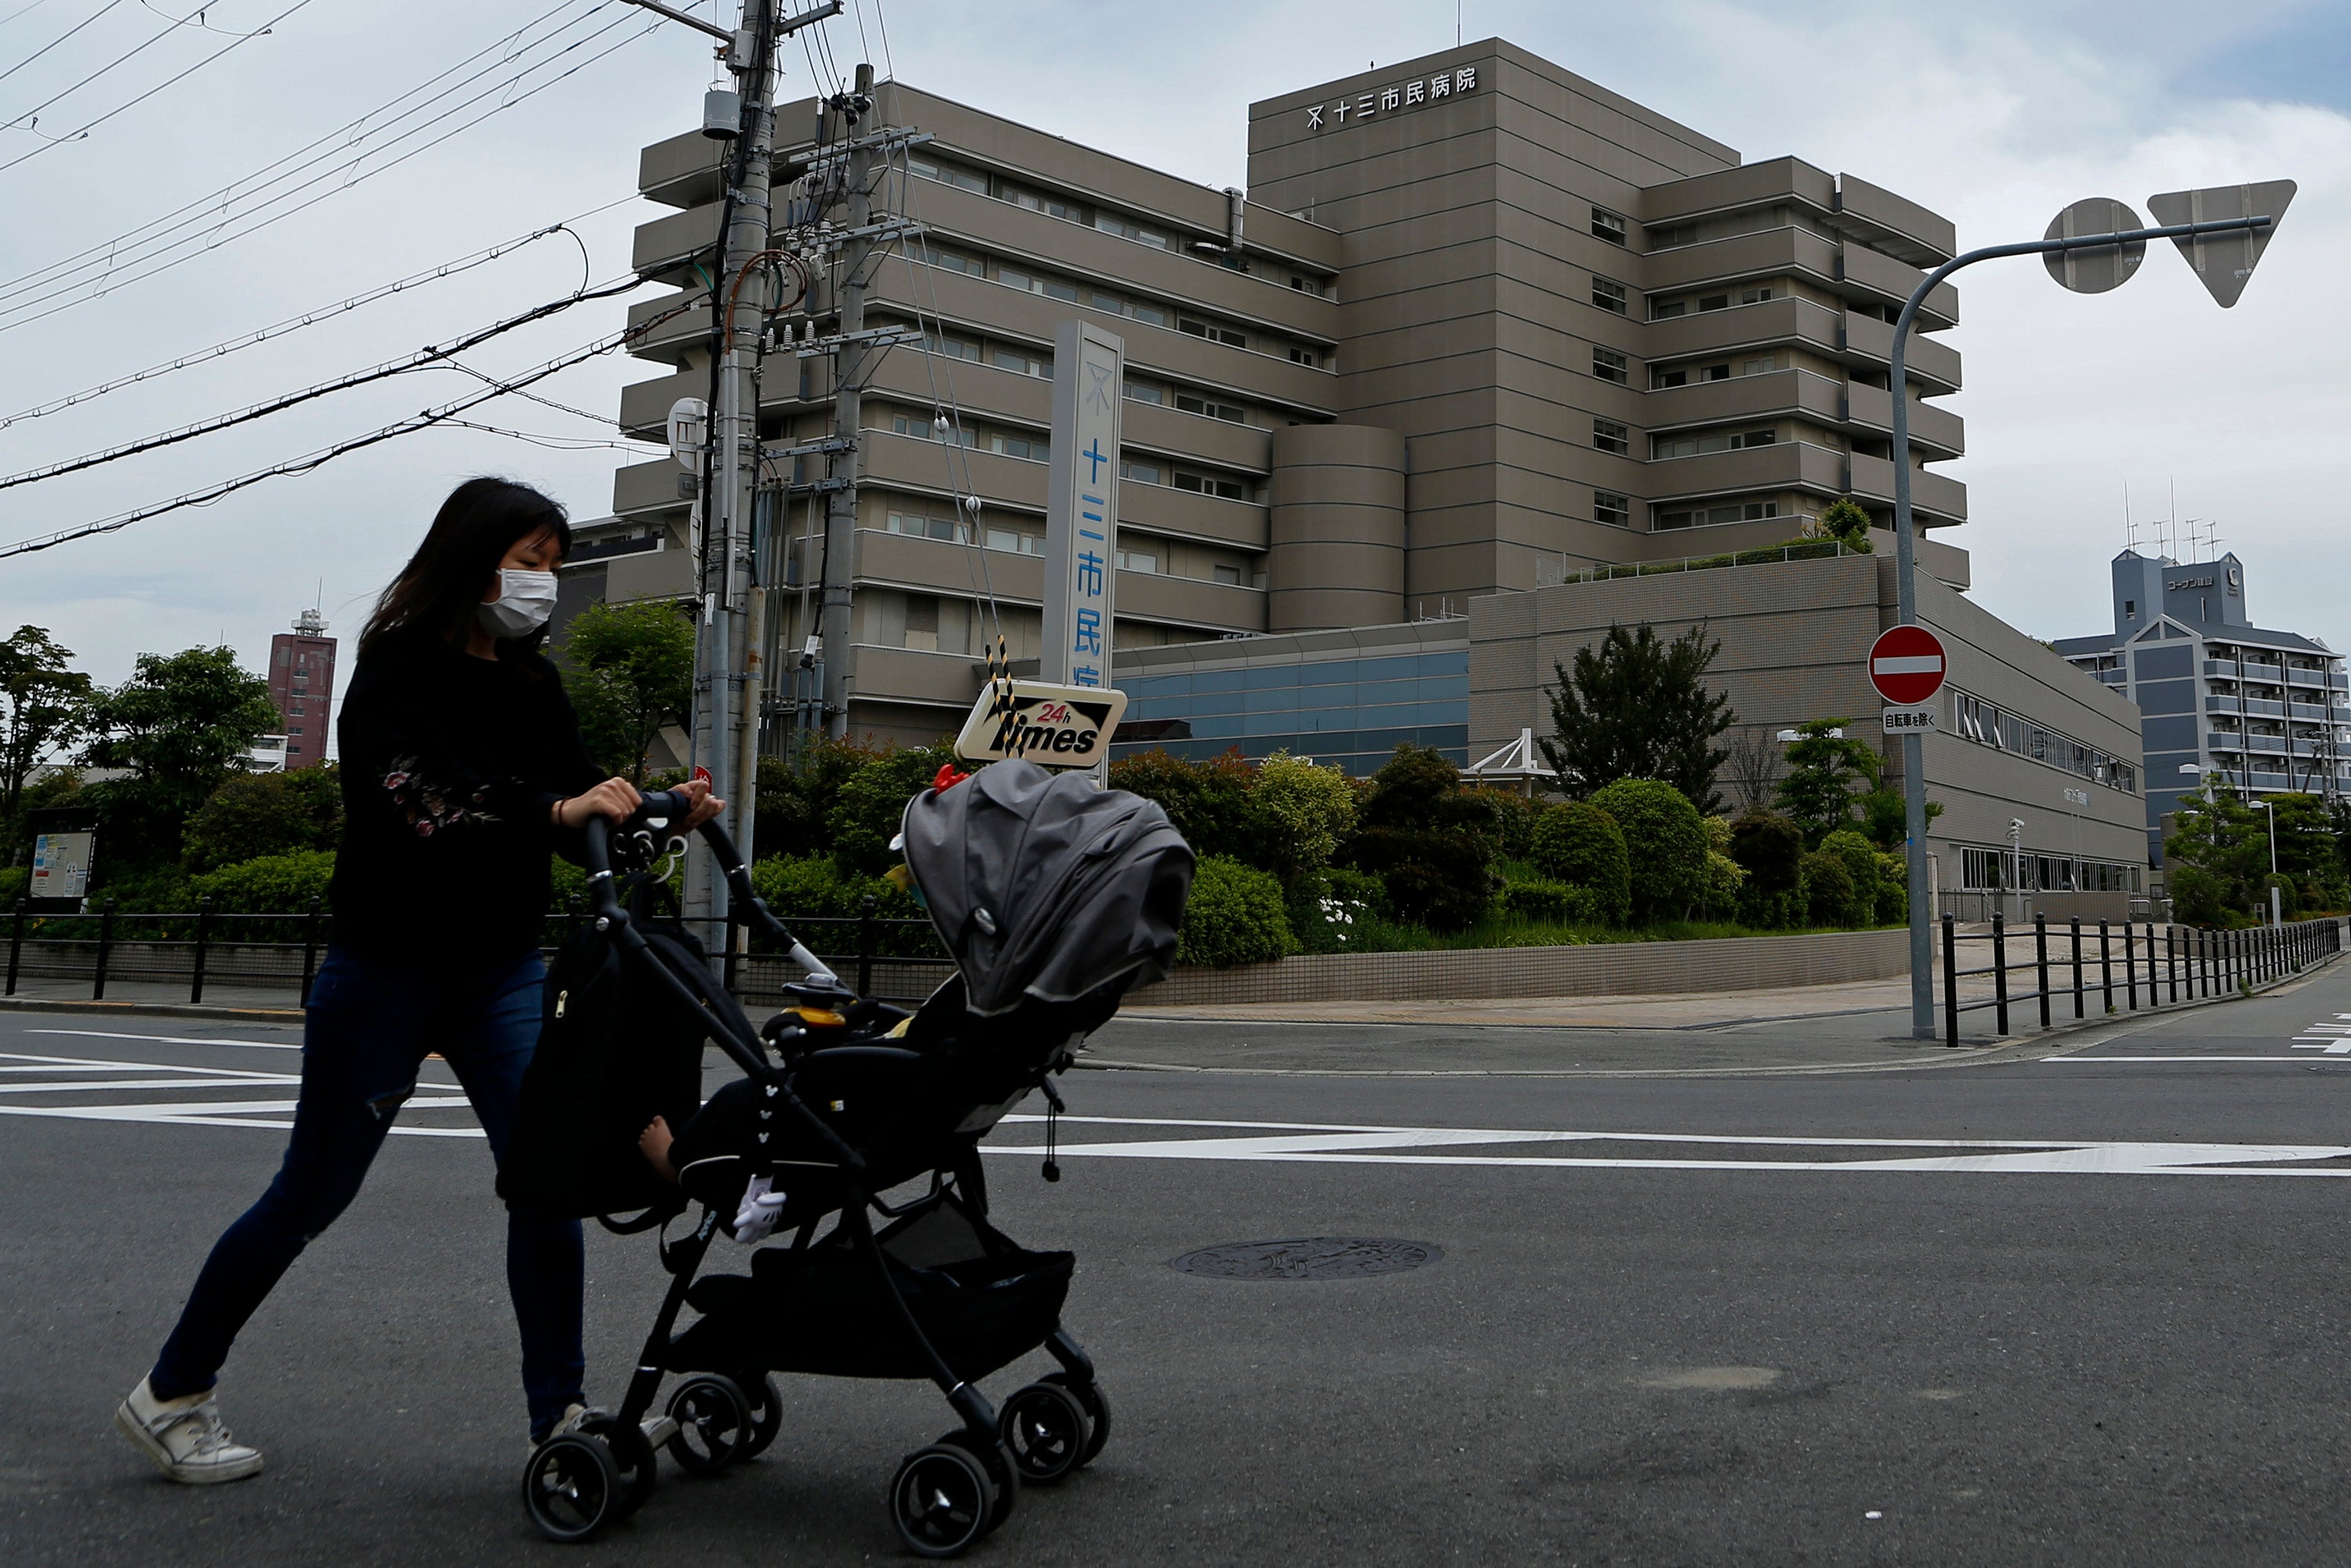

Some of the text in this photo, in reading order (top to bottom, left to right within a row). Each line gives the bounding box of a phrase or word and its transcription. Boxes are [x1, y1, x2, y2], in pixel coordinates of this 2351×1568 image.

[1334, 67, 1476, 123] 十三市民病院
[1886, 712, 1934, 728] 自転車を除く
